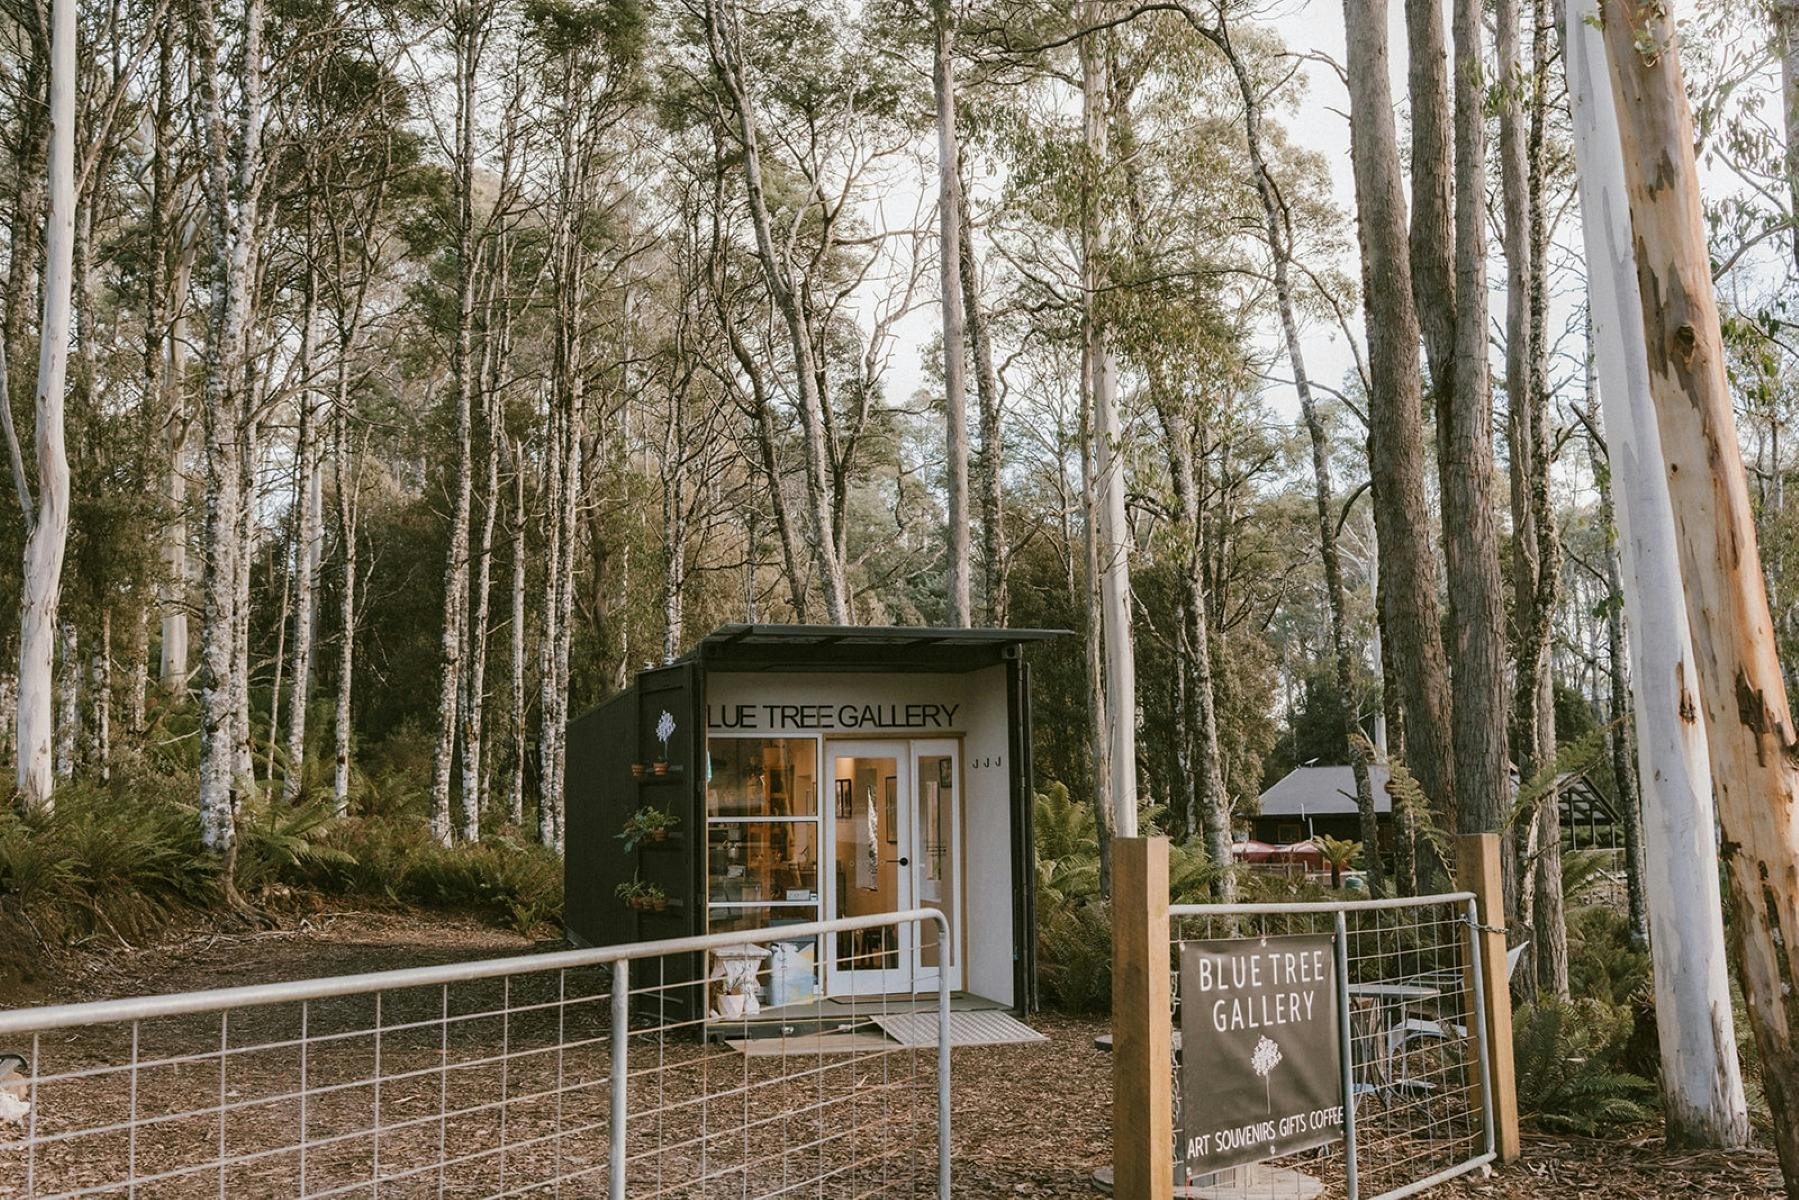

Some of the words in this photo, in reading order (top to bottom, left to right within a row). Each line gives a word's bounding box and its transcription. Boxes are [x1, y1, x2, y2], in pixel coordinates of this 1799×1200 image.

[707, 704, 757, 728] LUE
[762, 704, 834, 728] TREE
[838, 704, 960, 728] GALLERY
[1200, 955, 1262, 992] BLUE
[1268, 950, 1324, 985] TREE
[1212, 991, 1315, 1033] GALLERY
[1187, 1133, 1211, 1160] ART
[1214, 1120, 1276, 1152] SOUVENIRS
[1279, 1112, 1307, 1138] GIFTS
[1309, 1105, 1344, 1130] COFFEE
